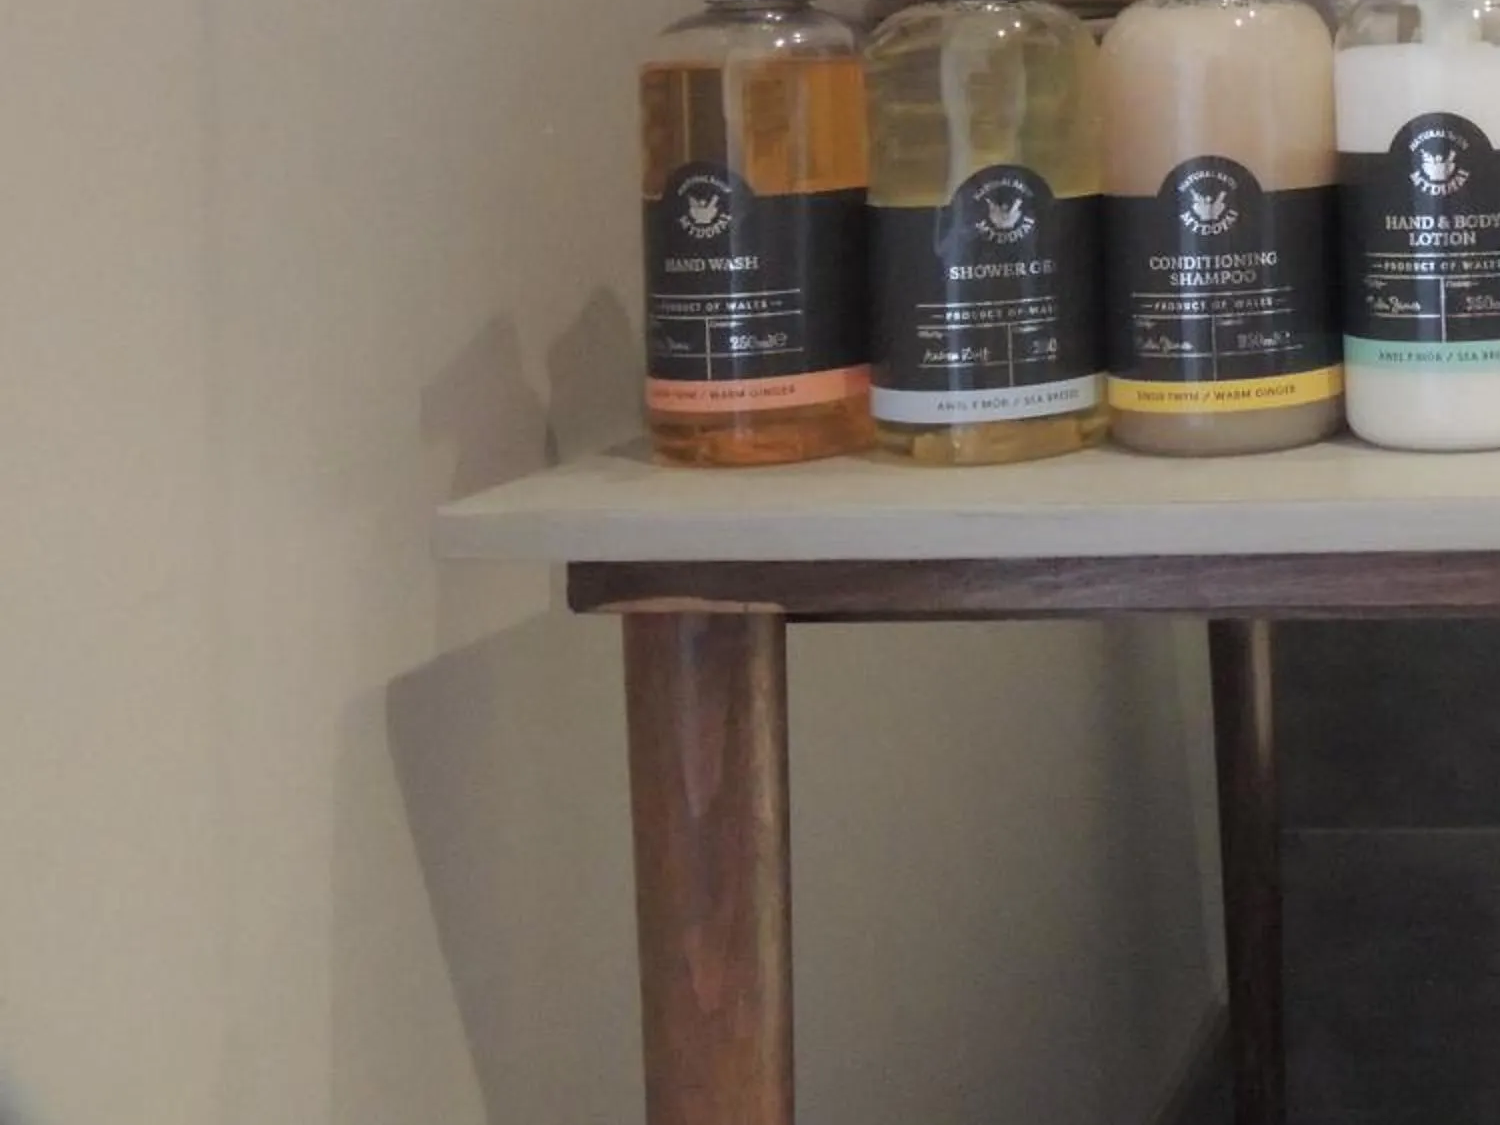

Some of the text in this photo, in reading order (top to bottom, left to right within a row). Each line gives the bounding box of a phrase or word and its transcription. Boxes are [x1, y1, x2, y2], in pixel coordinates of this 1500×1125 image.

[1385, 215, 1435, 231] HAND
[1437, 216, 1450, 230] &
[1409, 231, 1477, 247] LOTION
[665, 256, 759, 273] HAND WASH
[1149, 251, 1278, 271] CONDITIONING
[949, 263, 1027, 280] SHOWER
[1168, 269, 1257, 286] SHAMPOO
[1214, 388, 1250, 401] WARM
